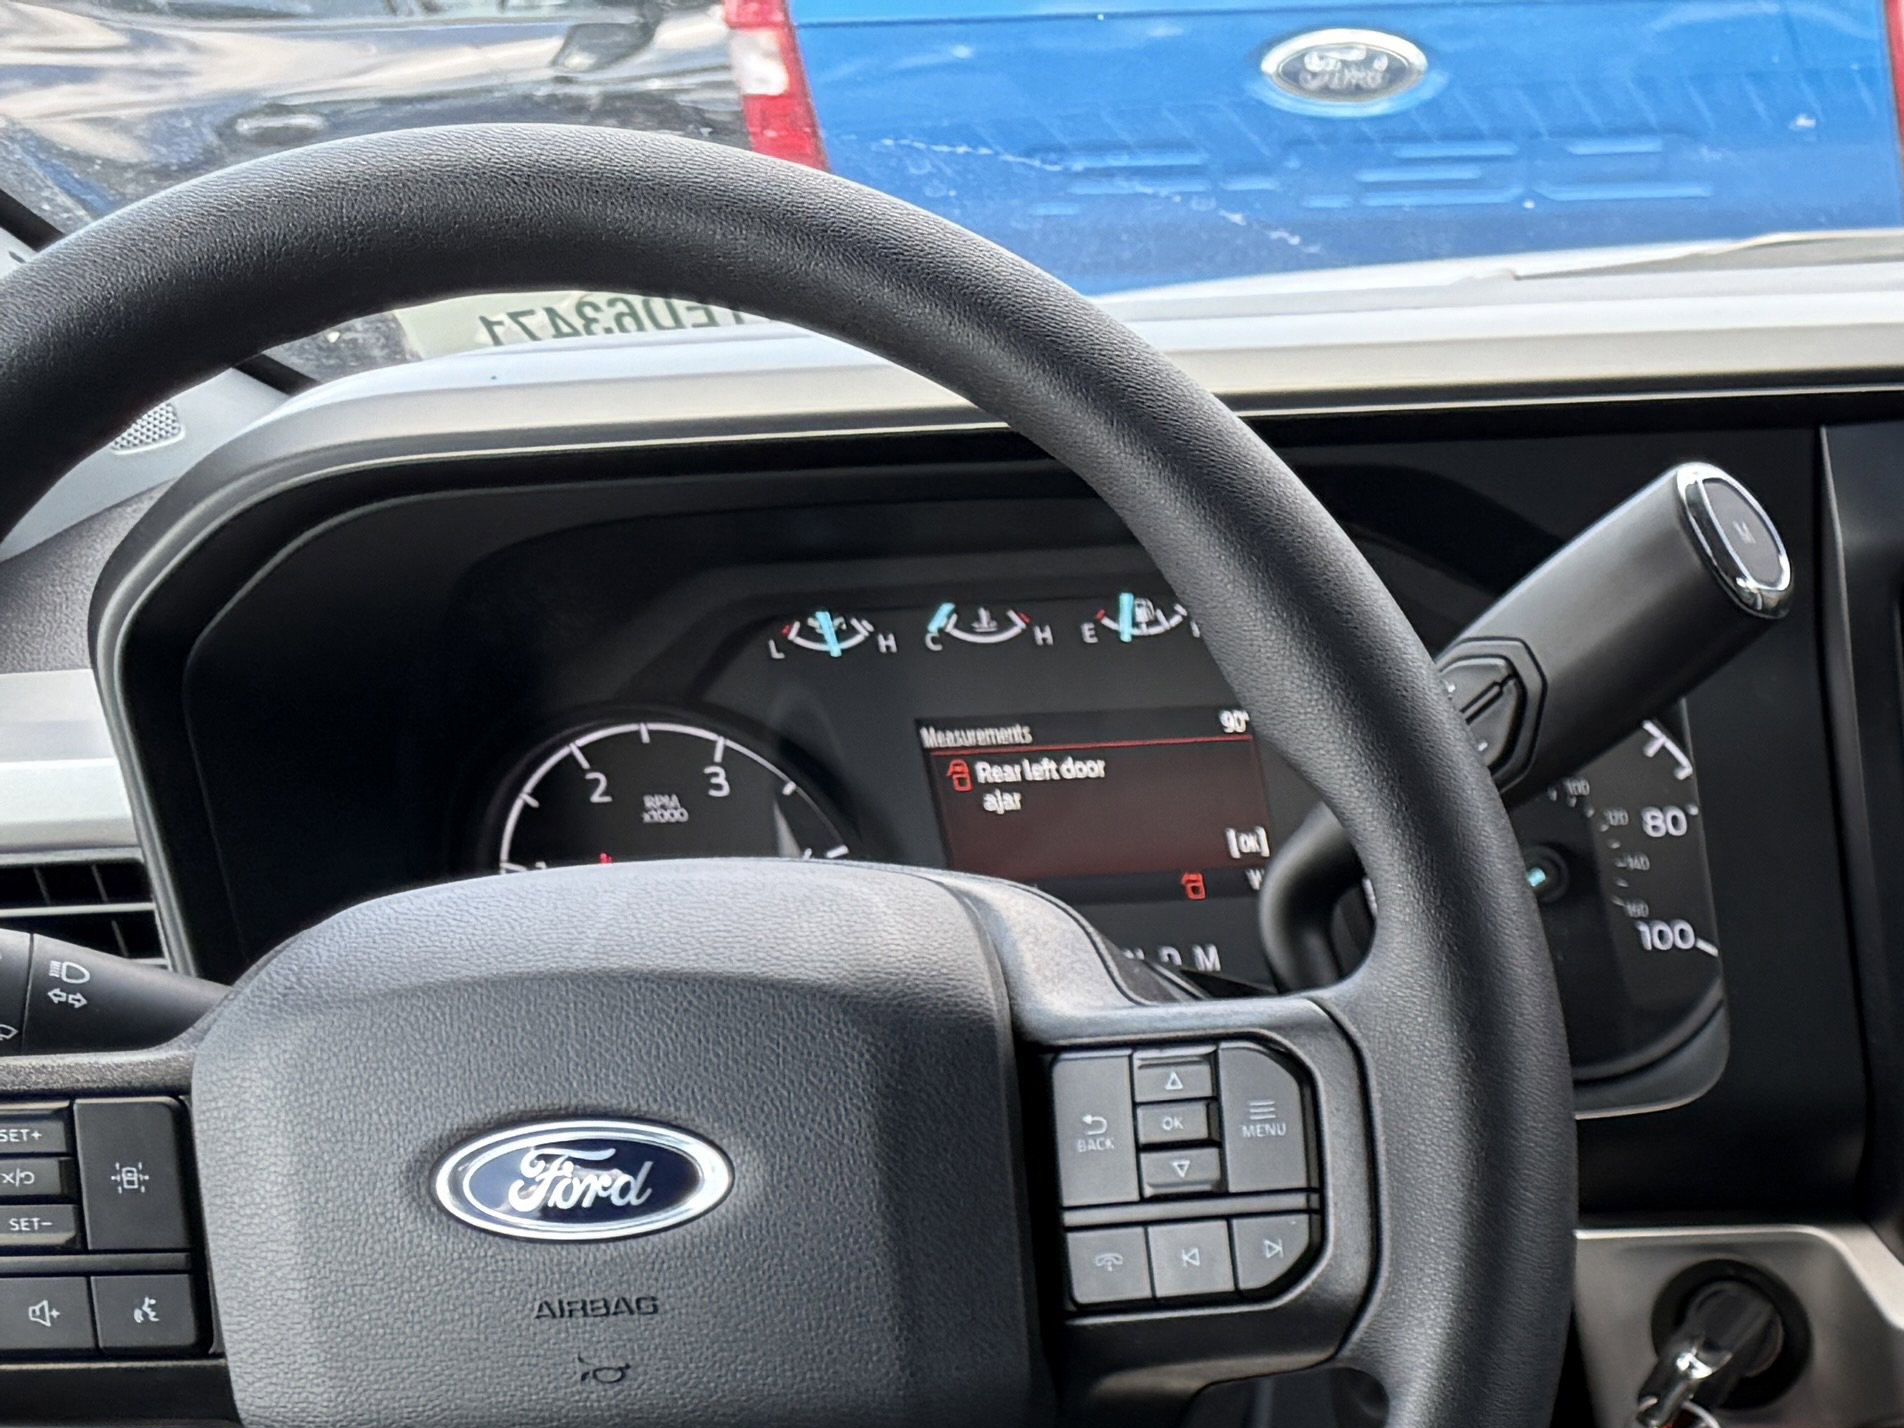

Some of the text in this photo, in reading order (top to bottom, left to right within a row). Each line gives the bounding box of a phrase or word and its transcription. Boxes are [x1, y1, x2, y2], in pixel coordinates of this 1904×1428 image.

[920, 723, 1033, 749] Measurements
[703, 766, 731, 798] 3
[975, 756, 1106, 784] Rear left door
[585, 771, 612, 803] 2
[983, 788, 1023, 814] ajar
[1641, 805, 1689, 838] 80
[1634, 918, 1696, 952] 100
[1161, 1117, 1184, 1131] OK
[1241, 1123, 1287, 1138] MENU
[1077, 1138, 1115, 1153] BACK
[508, 1147, 655, 1213] Ford
[534, 1296, 660, 1320] AIRBAG
